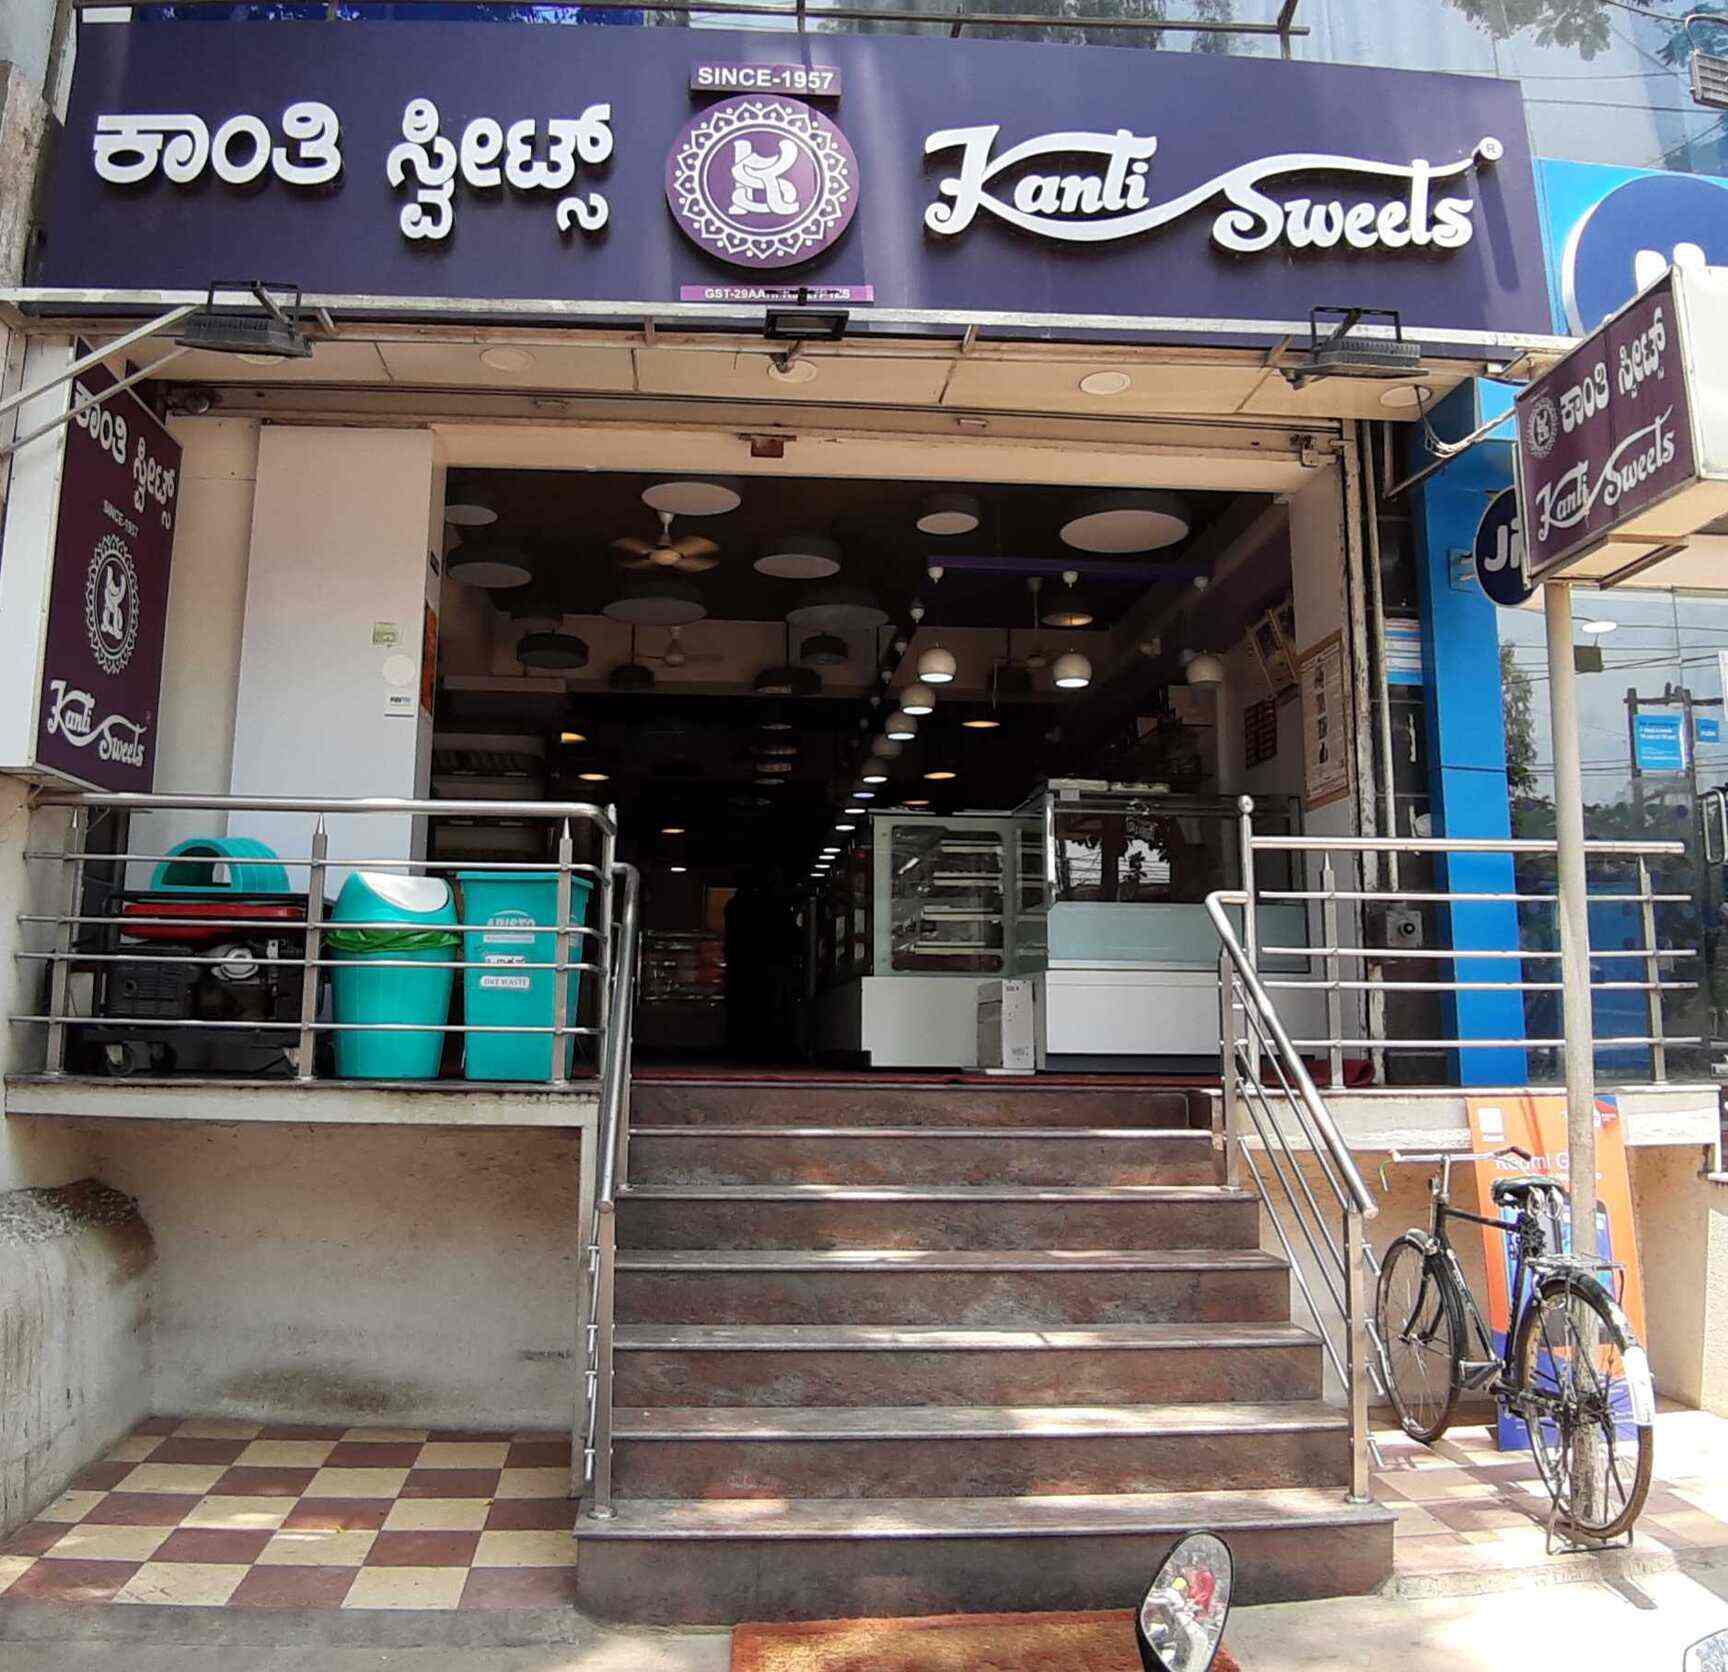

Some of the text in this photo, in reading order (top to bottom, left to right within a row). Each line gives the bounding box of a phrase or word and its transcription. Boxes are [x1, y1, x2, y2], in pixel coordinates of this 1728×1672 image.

[698, 67, 833, 89] SINCE-1957
[93, 101, 342, 185] ಕಾಂತಿ
[924, 124, 1160, 242] Kanti
[1211, 153, 1478, 252] Sweets
[1560, 362, 1610, 433] ಕಾಂತಿ
[1535, 460, 1593, 542] Kanti
[1603, 404, 1675, 506] Sweets
[1484, 517, 1520, 571] Ji
[48, 680, 148, 767] Kanti Sweets
